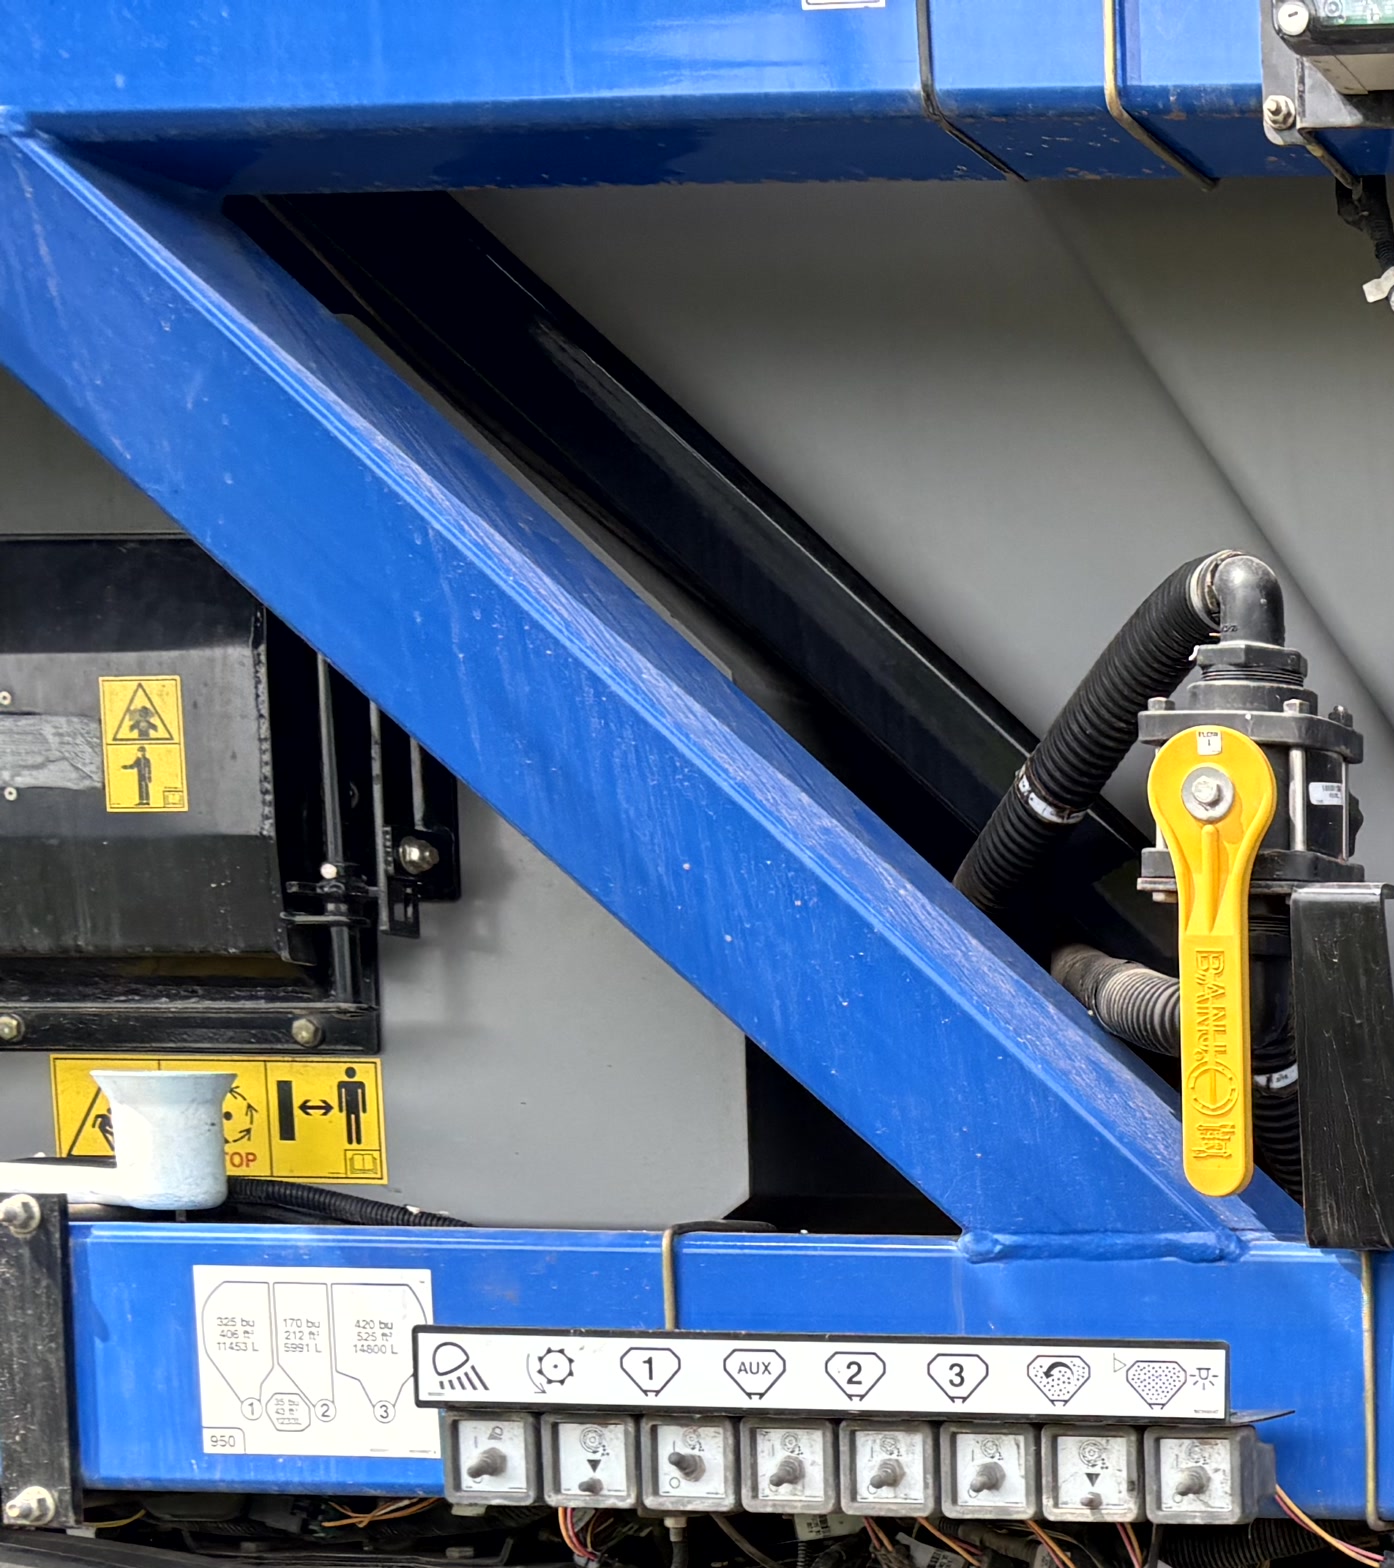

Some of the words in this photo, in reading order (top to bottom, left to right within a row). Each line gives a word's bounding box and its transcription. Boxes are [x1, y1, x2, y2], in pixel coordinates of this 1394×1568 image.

[224, 1151, 258, 1169] OP
[282, 1317, 303, 1329] 170
[354, 1319, 376, 1330] 420
[284, 1330, 305, 1341] 212
[356, 1331, 378, 1342] 525
[251, 1341, 260, 1352] L
[314, 1342, 323, 1353] L
[390, 1343, 399, 1355] L
[641, 1356, 654, 1381] 1
[737, 1361, 772, 1375] AUX
[846, 1360, 863, 1385] 2
[949, 1363, 965, 1388] 3
[248, 1402, 255, 1416] 1
[320, 1402, 331, 1417] 2
[379, 1403, 390, 1418] 3
[210, 1434, 236, 1448] 950
